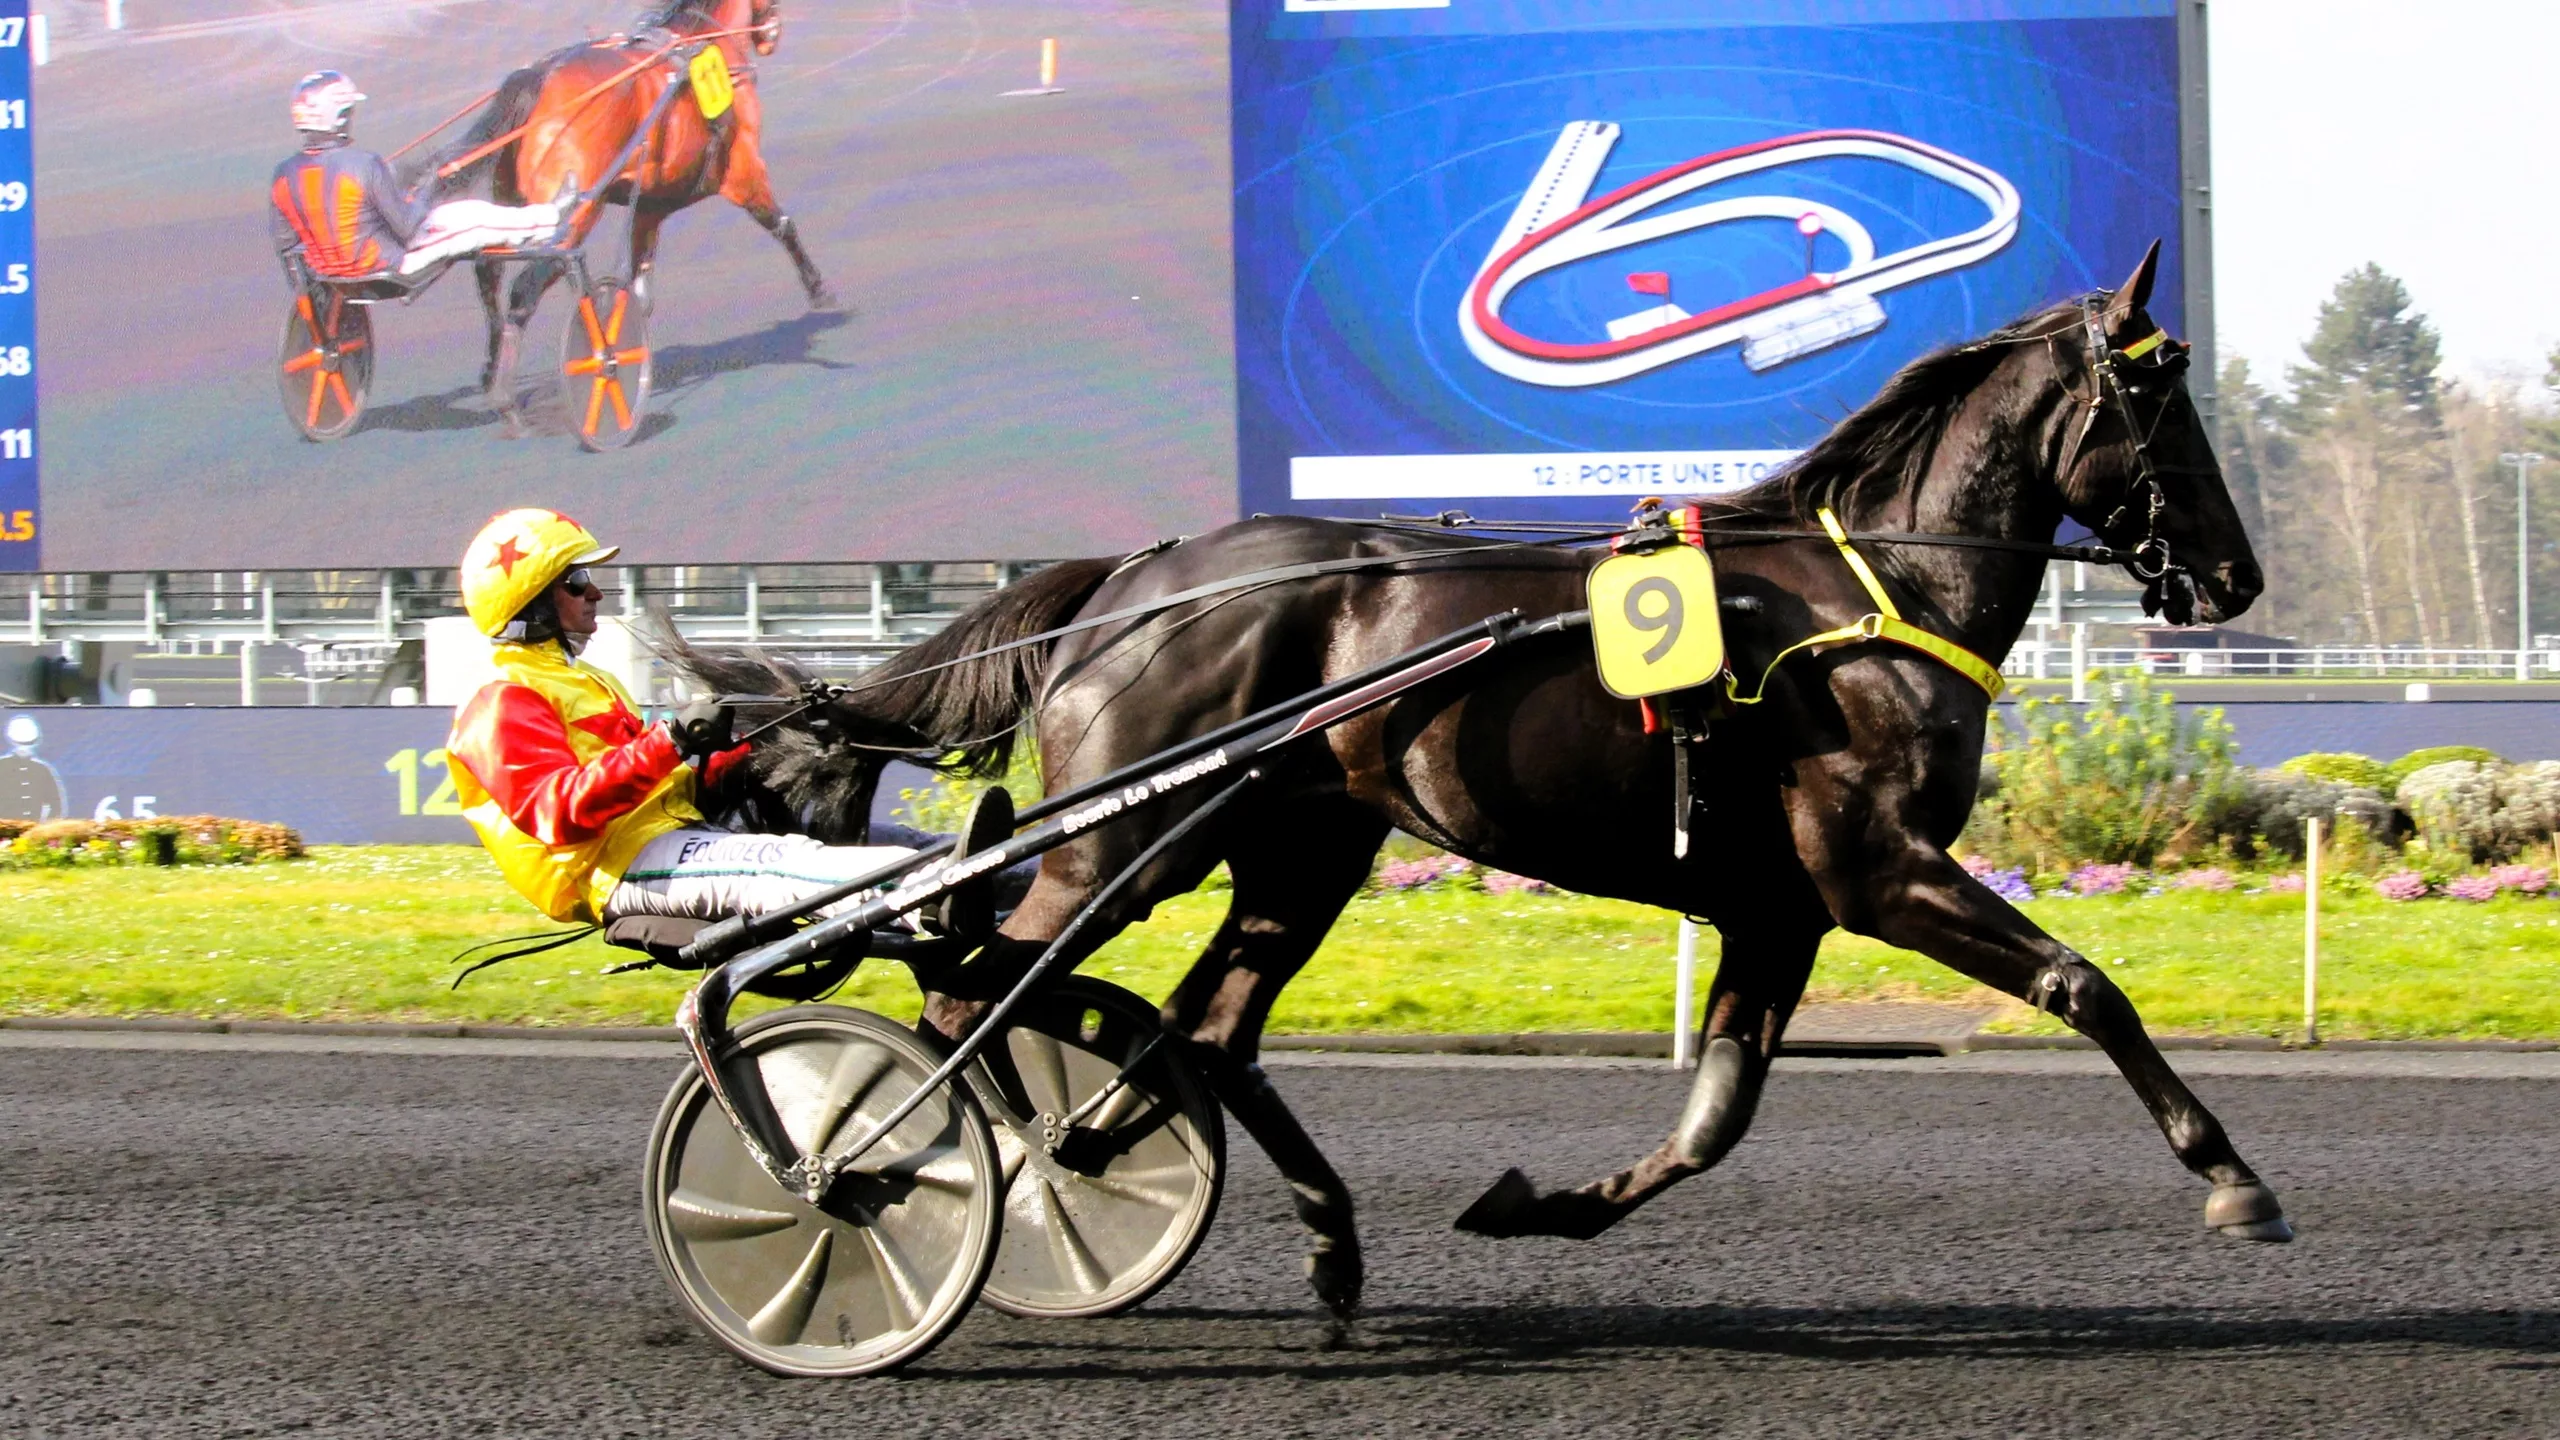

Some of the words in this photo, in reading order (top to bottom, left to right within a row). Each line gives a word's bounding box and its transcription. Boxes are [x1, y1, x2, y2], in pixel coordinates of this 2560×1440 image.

[1533, 465, 1556, 486] 12
[1579, 463, 1663, 485] PORTE
[1672, 462, 1724, 483] UNE
[1623, 576, 1684, 665] 9
[384, 749, 463, 816] 12
[1150, 748, 1228, 793] Tremont
